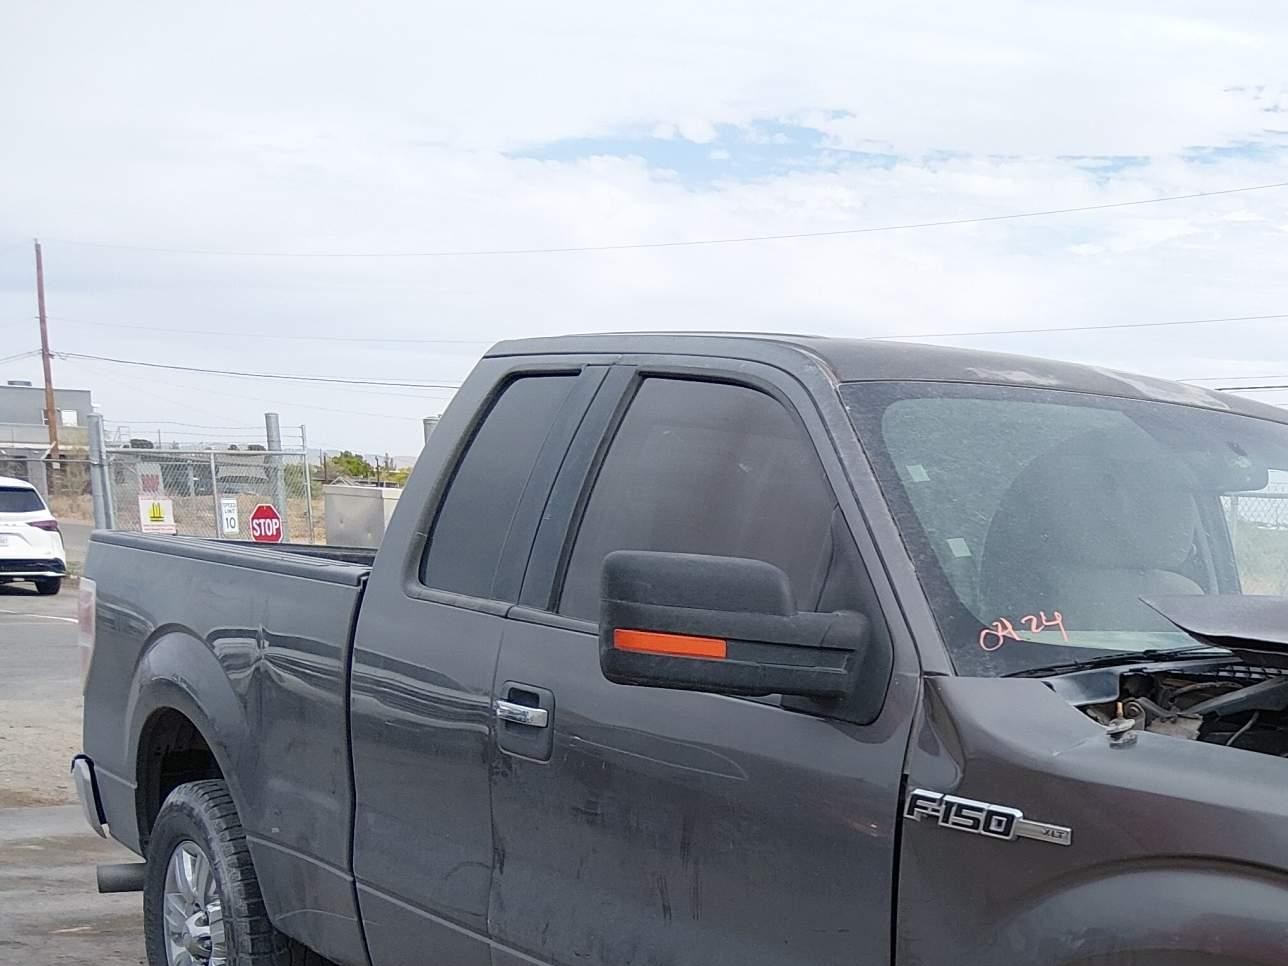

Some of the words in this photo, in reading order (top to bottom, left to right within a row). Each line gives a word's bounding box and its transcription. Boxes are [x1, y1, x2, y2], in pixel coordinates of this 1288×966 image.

[225, 516, 237, 529] 10
[252, 518, 280, 537] STOP
[904, 788, 1023, 840] F-150
[1041, 827, 1066, 840] XLT
